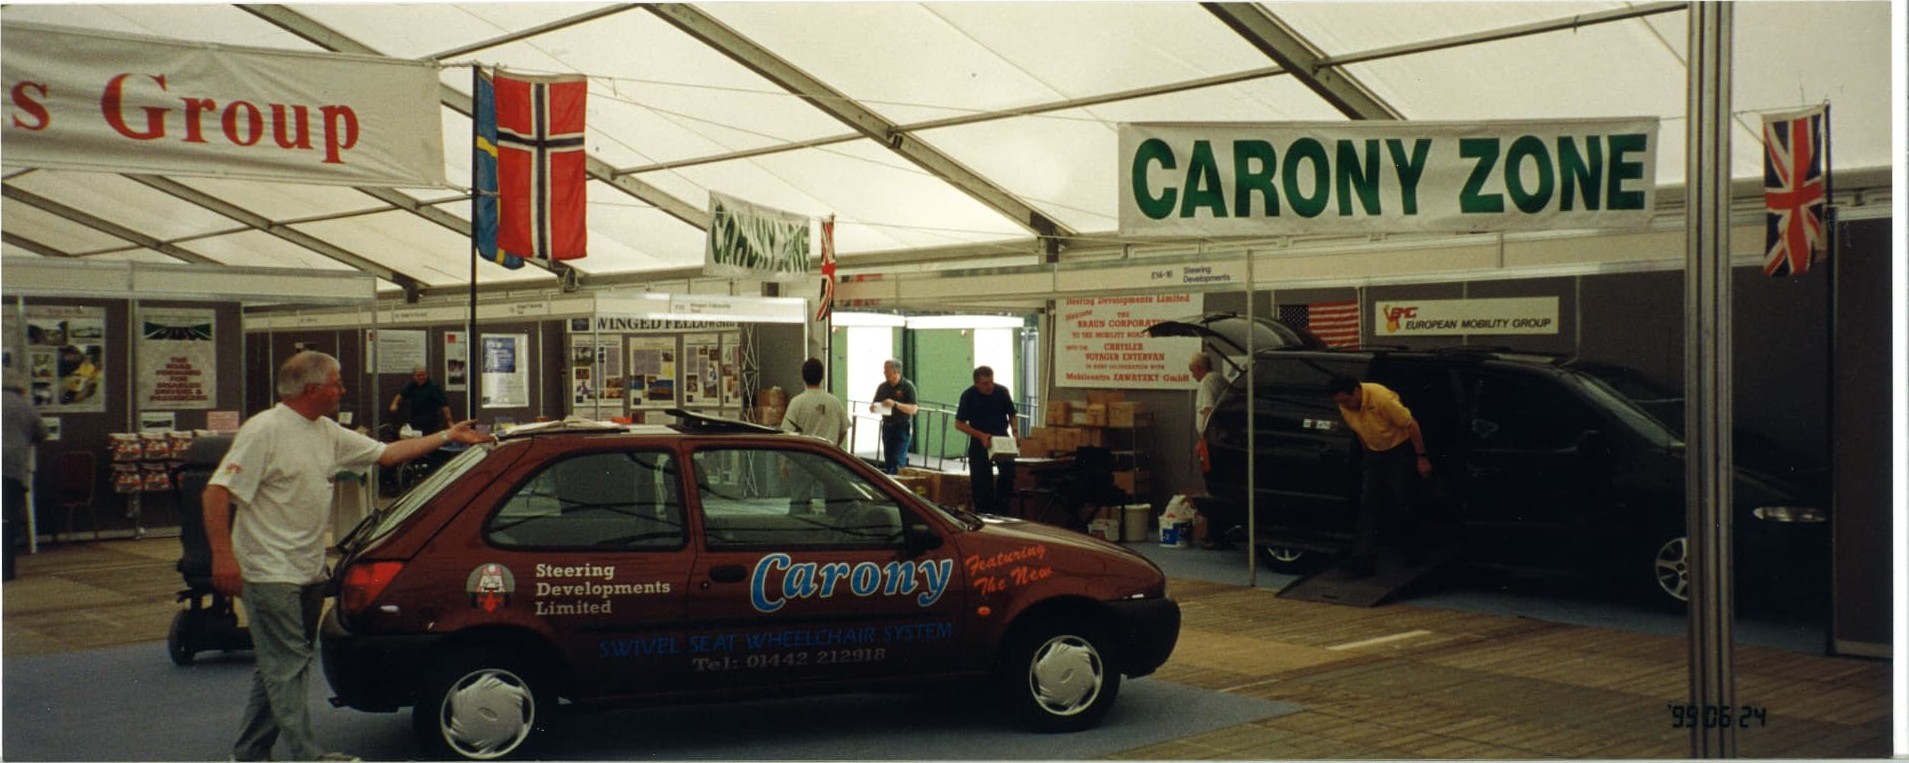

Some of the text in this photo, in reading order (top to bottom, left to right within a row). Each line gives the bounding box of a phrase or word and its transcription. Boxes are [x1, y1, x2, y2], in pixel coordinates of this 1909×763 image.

[11, 72, 359, 164] s Group
[1132, 133, 1647, 220] CARONY ZONE
[1157, 294, 1189, 303] Limited
[597, 317, 661, 330] WINGED
[1078, 320, 1105, 328] BRAUN
[1405, 318, 1551, 330] EUROPEAN MOBILITY GROUP
[1095, 331, 1125, 339] MOBILITY
[1103, 343, 1143, 351] CHRYSLER
[1086, 353, 1165, 361] VOYAGER ENTERVAN
[1163, 373, 1190, 383] GmbH
[964, 544, 1047, 576] Featuring
[536, 563, 616, 580] Steering
[750, 552, 954, 613] Carony
[972, 564, 1054, 597] The New
[536, 581, 671, 599] Developments
[535, 600, 612, 616] Limited
[599, 622, 955, 659] SWIVEL SEAT WHEELCHAIR SYSTEM
[692, 648, 887, 673] Tel: 01442 212918
